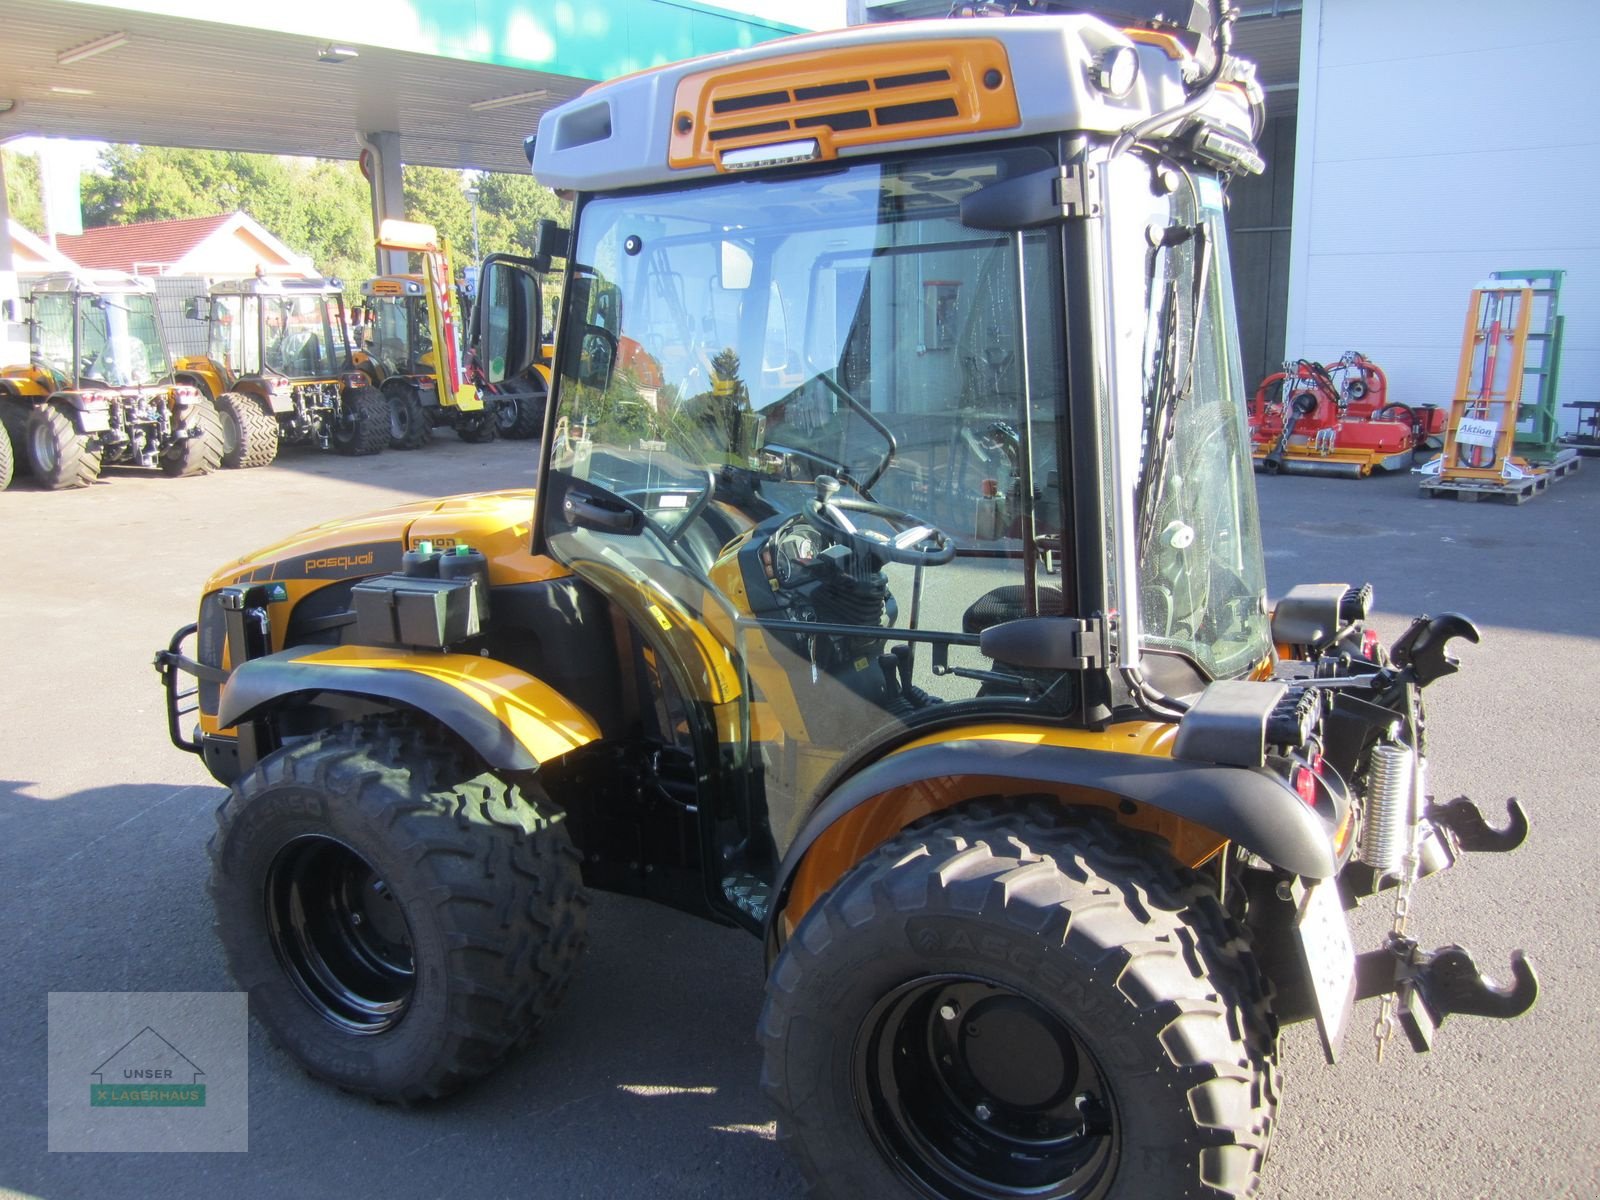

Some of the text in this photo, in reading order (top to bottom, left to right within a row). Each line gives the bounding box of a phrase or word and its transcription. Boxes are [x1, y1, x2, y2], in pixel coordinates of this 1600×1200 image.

[1460, 424, 1492, 436] Aktion
[413, 538, 456, 547] oion
[305, 551, 374, 574] pasquali
[945, 929, 1143, 1065] ASCENO
